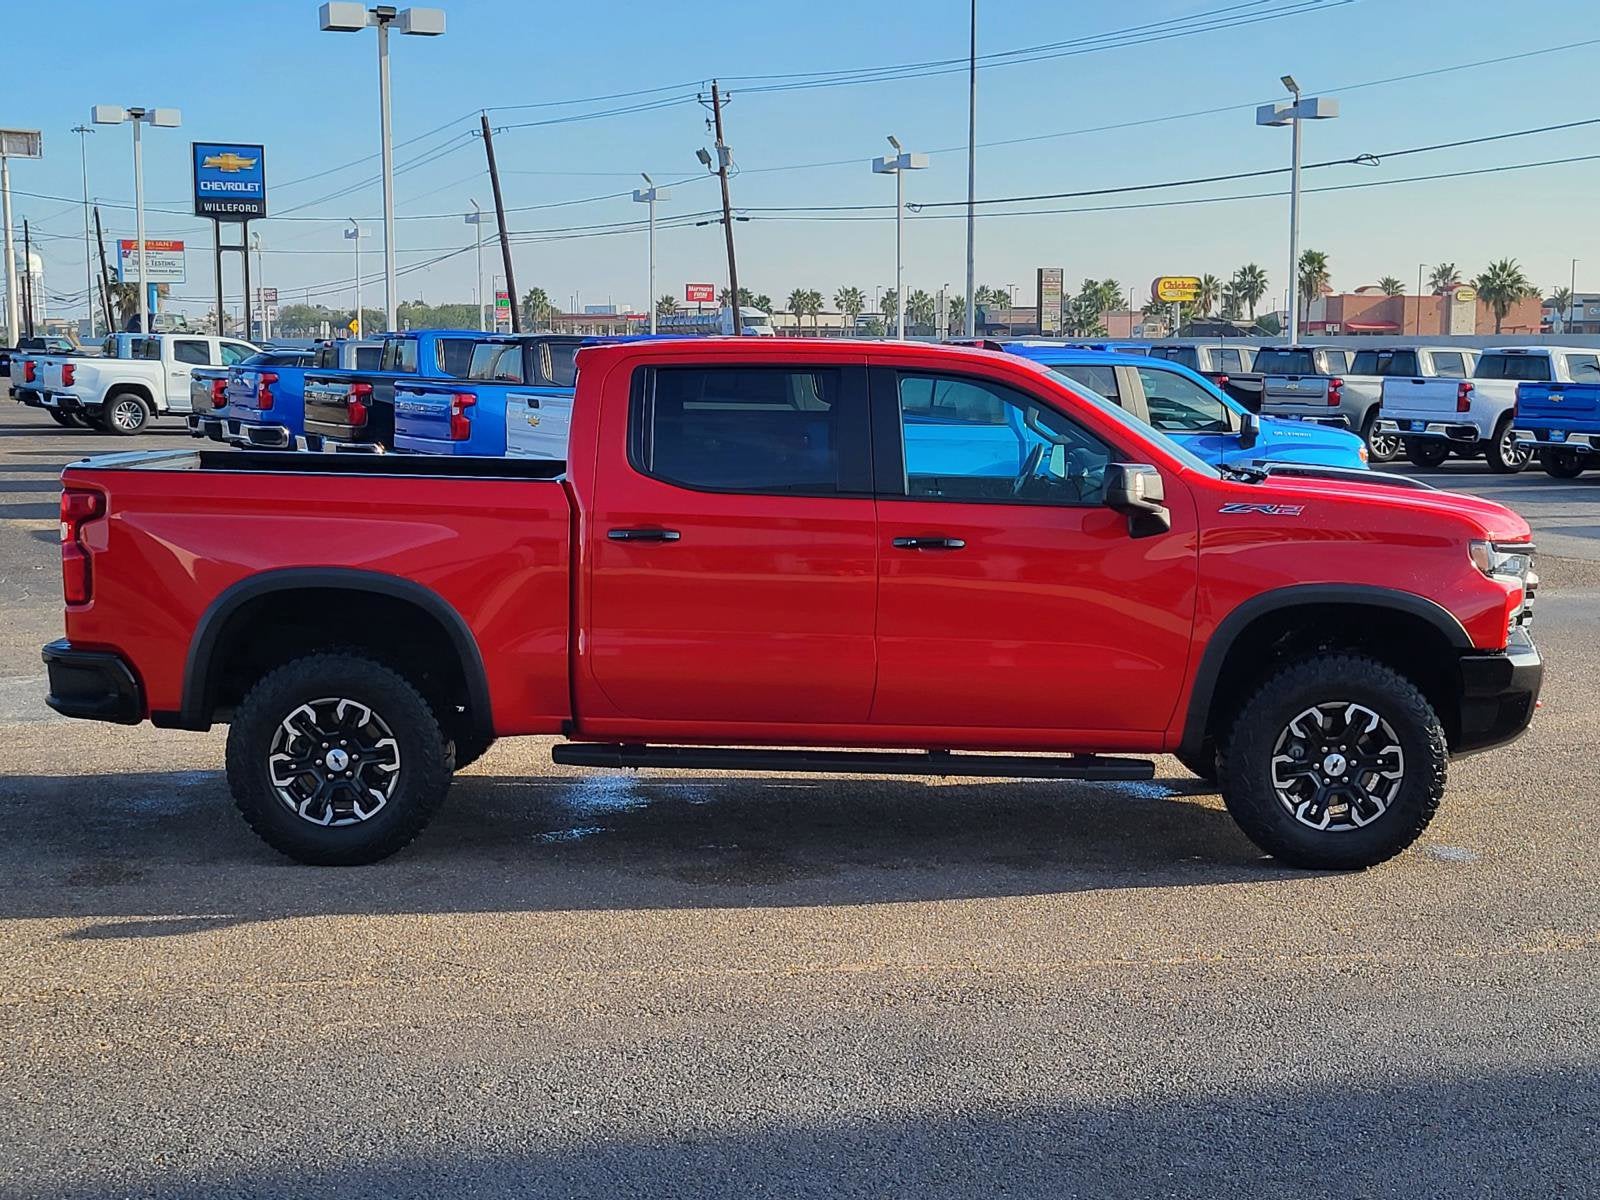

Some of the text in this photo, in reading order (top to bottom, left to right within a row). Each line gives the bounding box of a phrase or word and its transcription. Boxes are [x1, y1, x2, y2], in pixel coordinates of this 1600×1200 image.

[200, 181, 260, 192] CHEVROLET
[204, 203, 258, 212] WILLEFORD
[1218, 502, 1306, 517] ZR2
